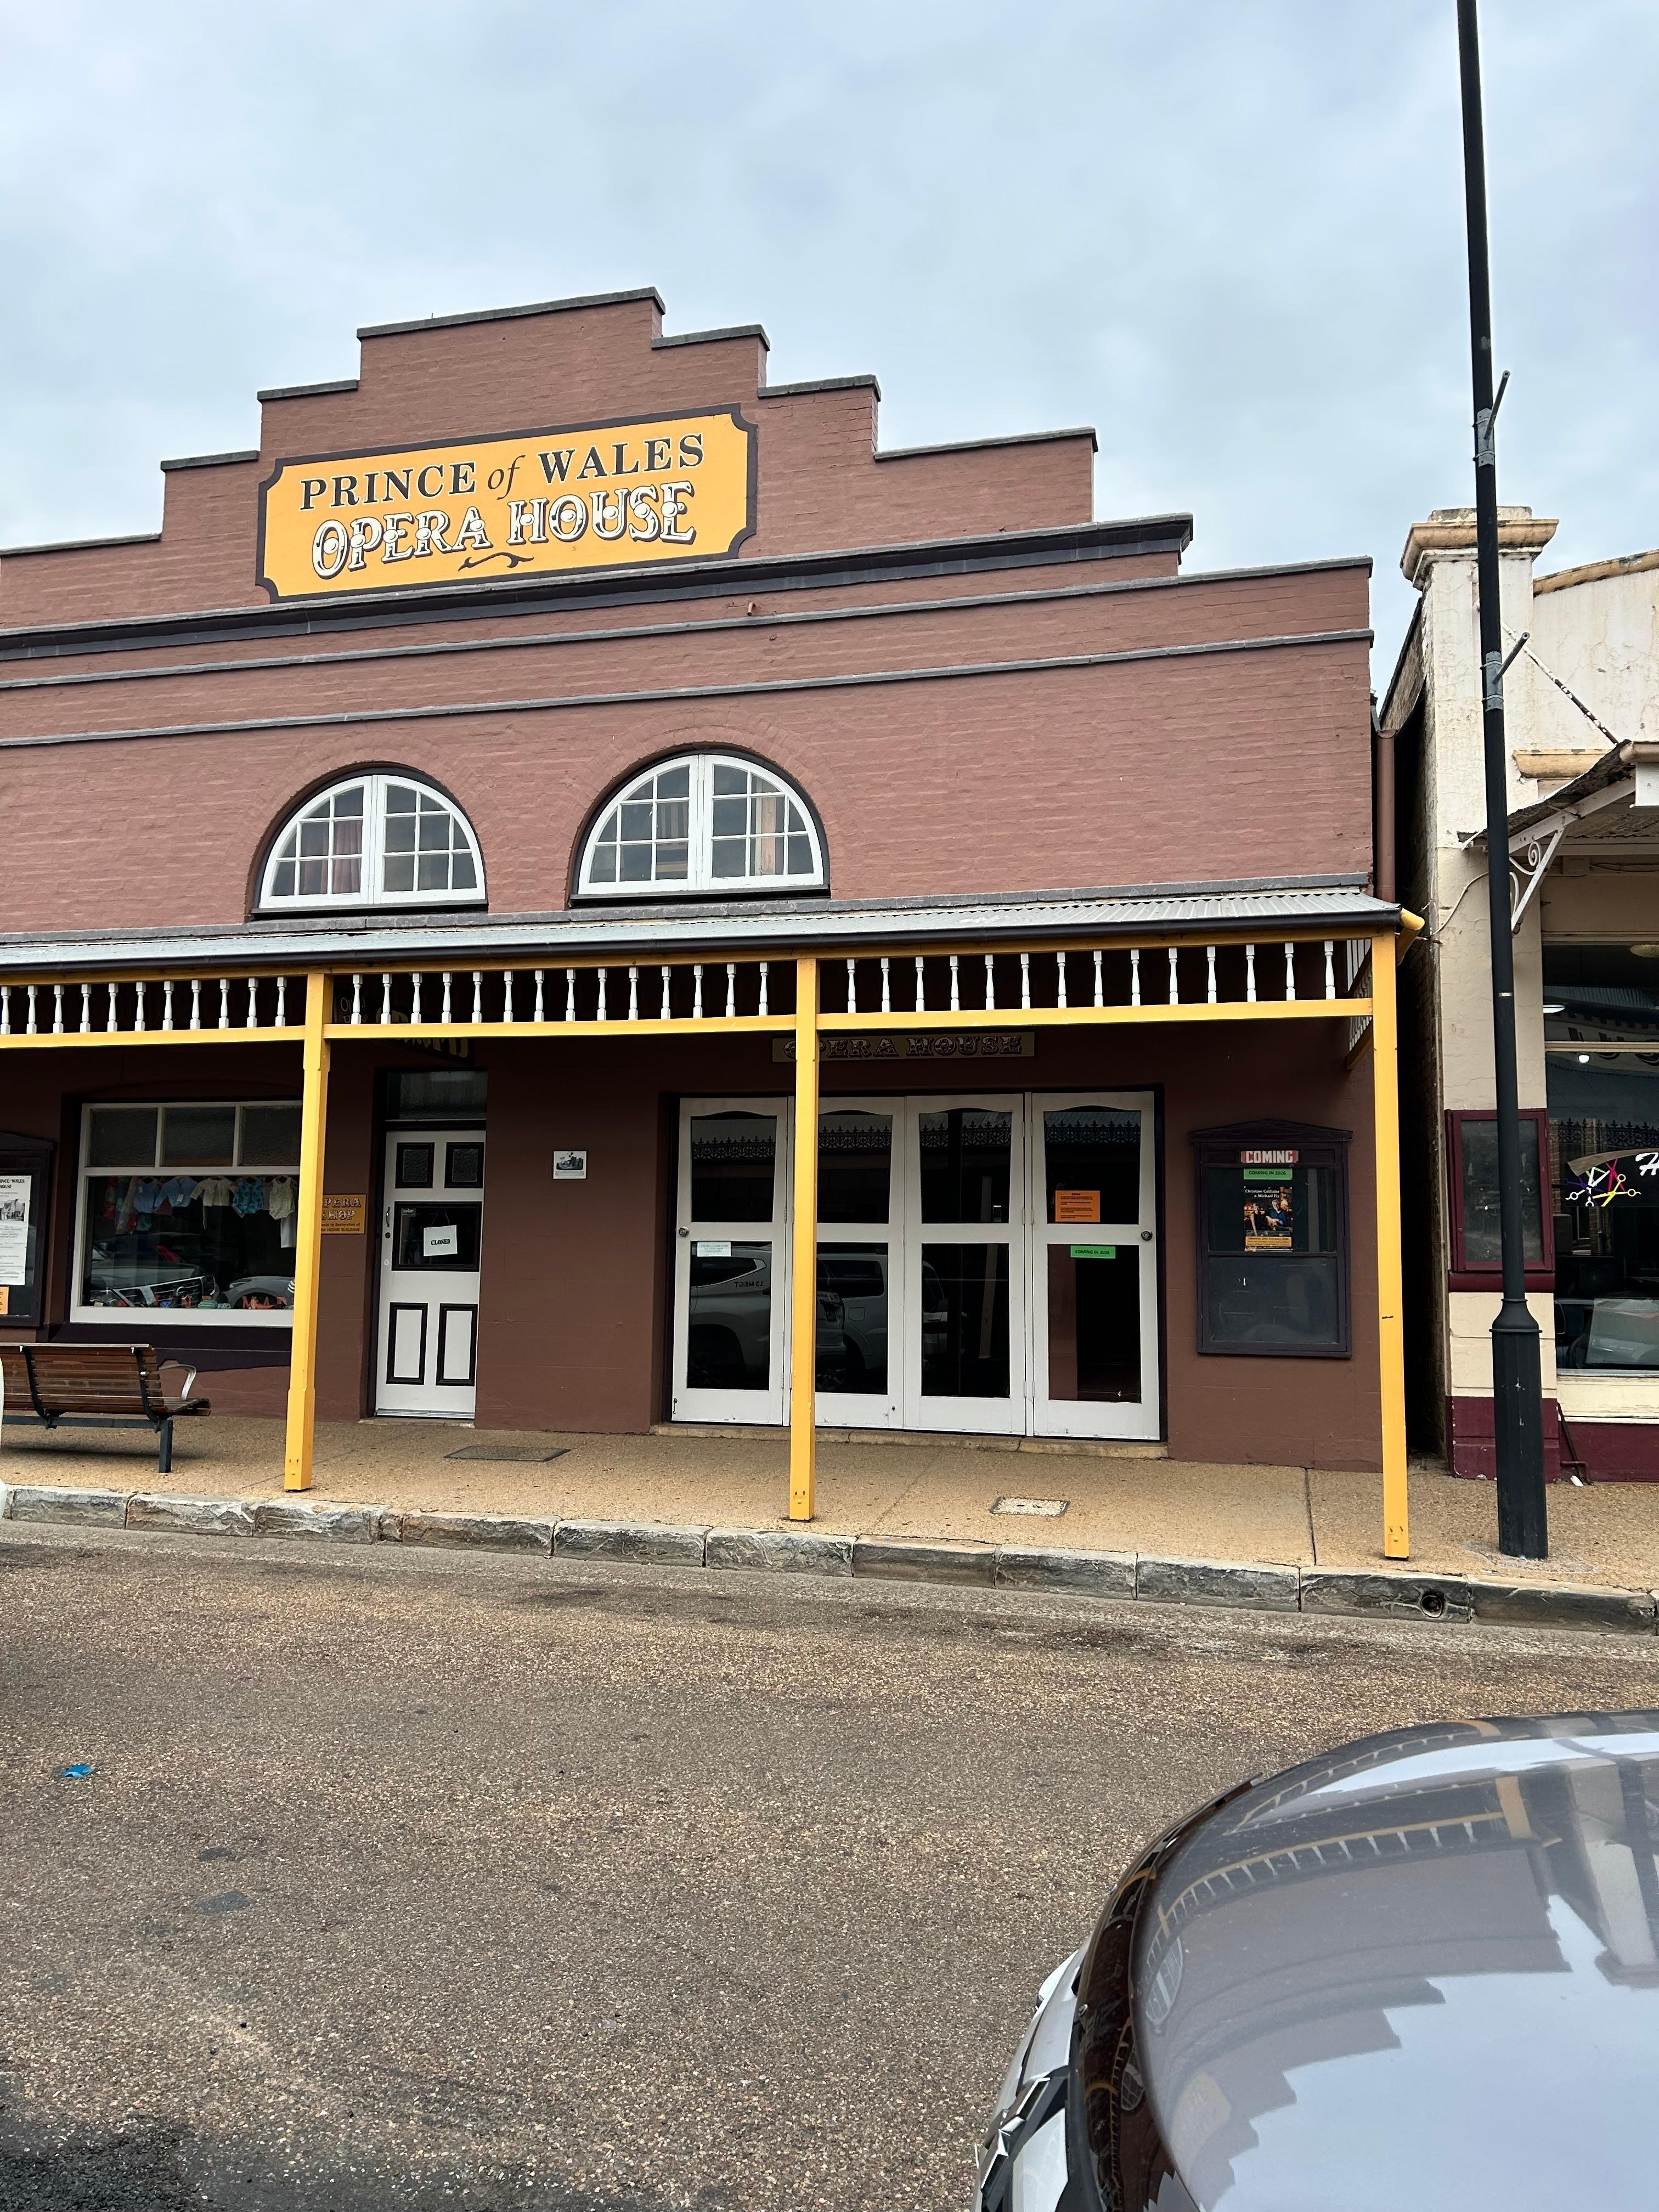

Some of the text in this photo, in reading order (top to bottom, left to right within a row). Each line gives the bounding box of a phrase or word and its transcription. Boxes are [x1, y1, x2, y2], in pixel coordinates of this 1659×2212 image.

[298, 433, 704, 510] PRINCE of WALES
[311, 480, 697, 579] OPERA HOUSE
[783, 1035, 1022, 1058] OERA HOUSE
[1246, 1150, 1293, 1164] COMING
[323, 1197, 362, 1208] PERA
